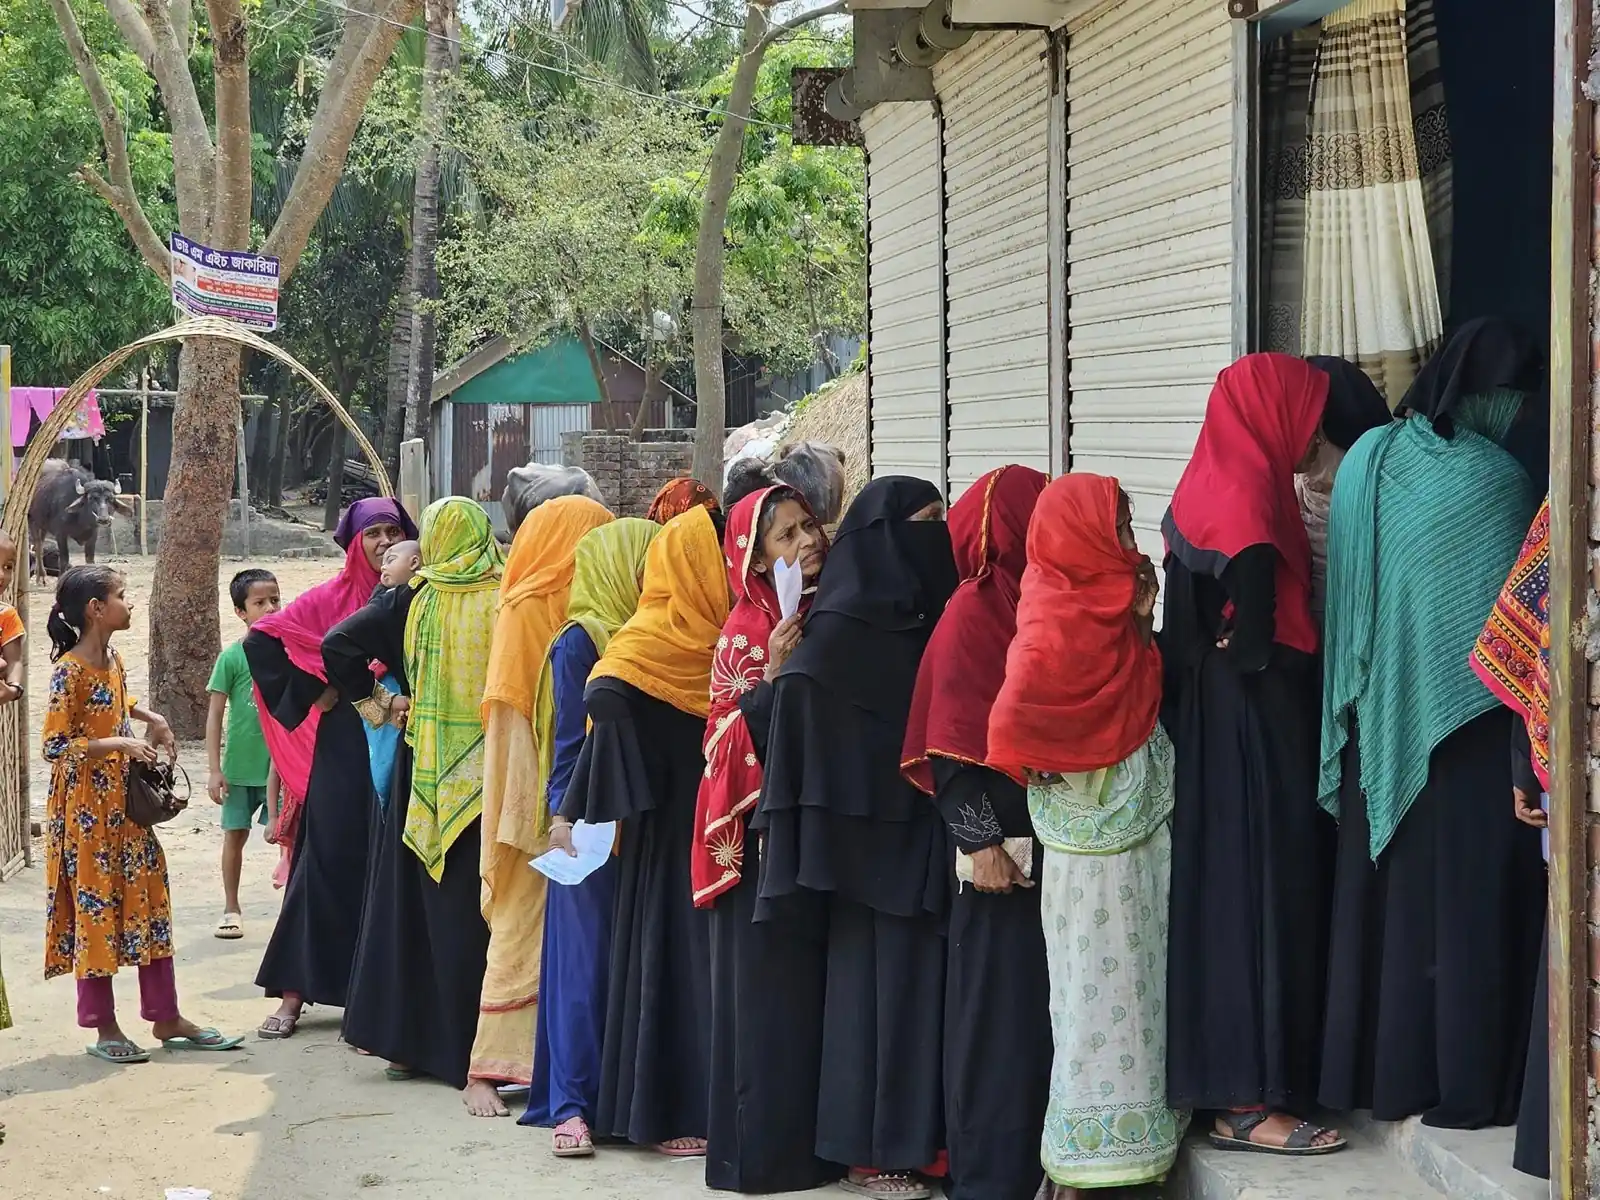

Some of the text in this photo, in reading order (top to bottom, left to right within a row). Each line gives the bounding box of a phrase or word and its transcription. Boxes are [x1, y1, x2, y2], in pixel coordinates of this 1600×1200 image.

[174, 237, 189, 253] ডাঃ
[190, 247, 203, 261] এম
[231, 256, 277, 274] জাকারিয়া
